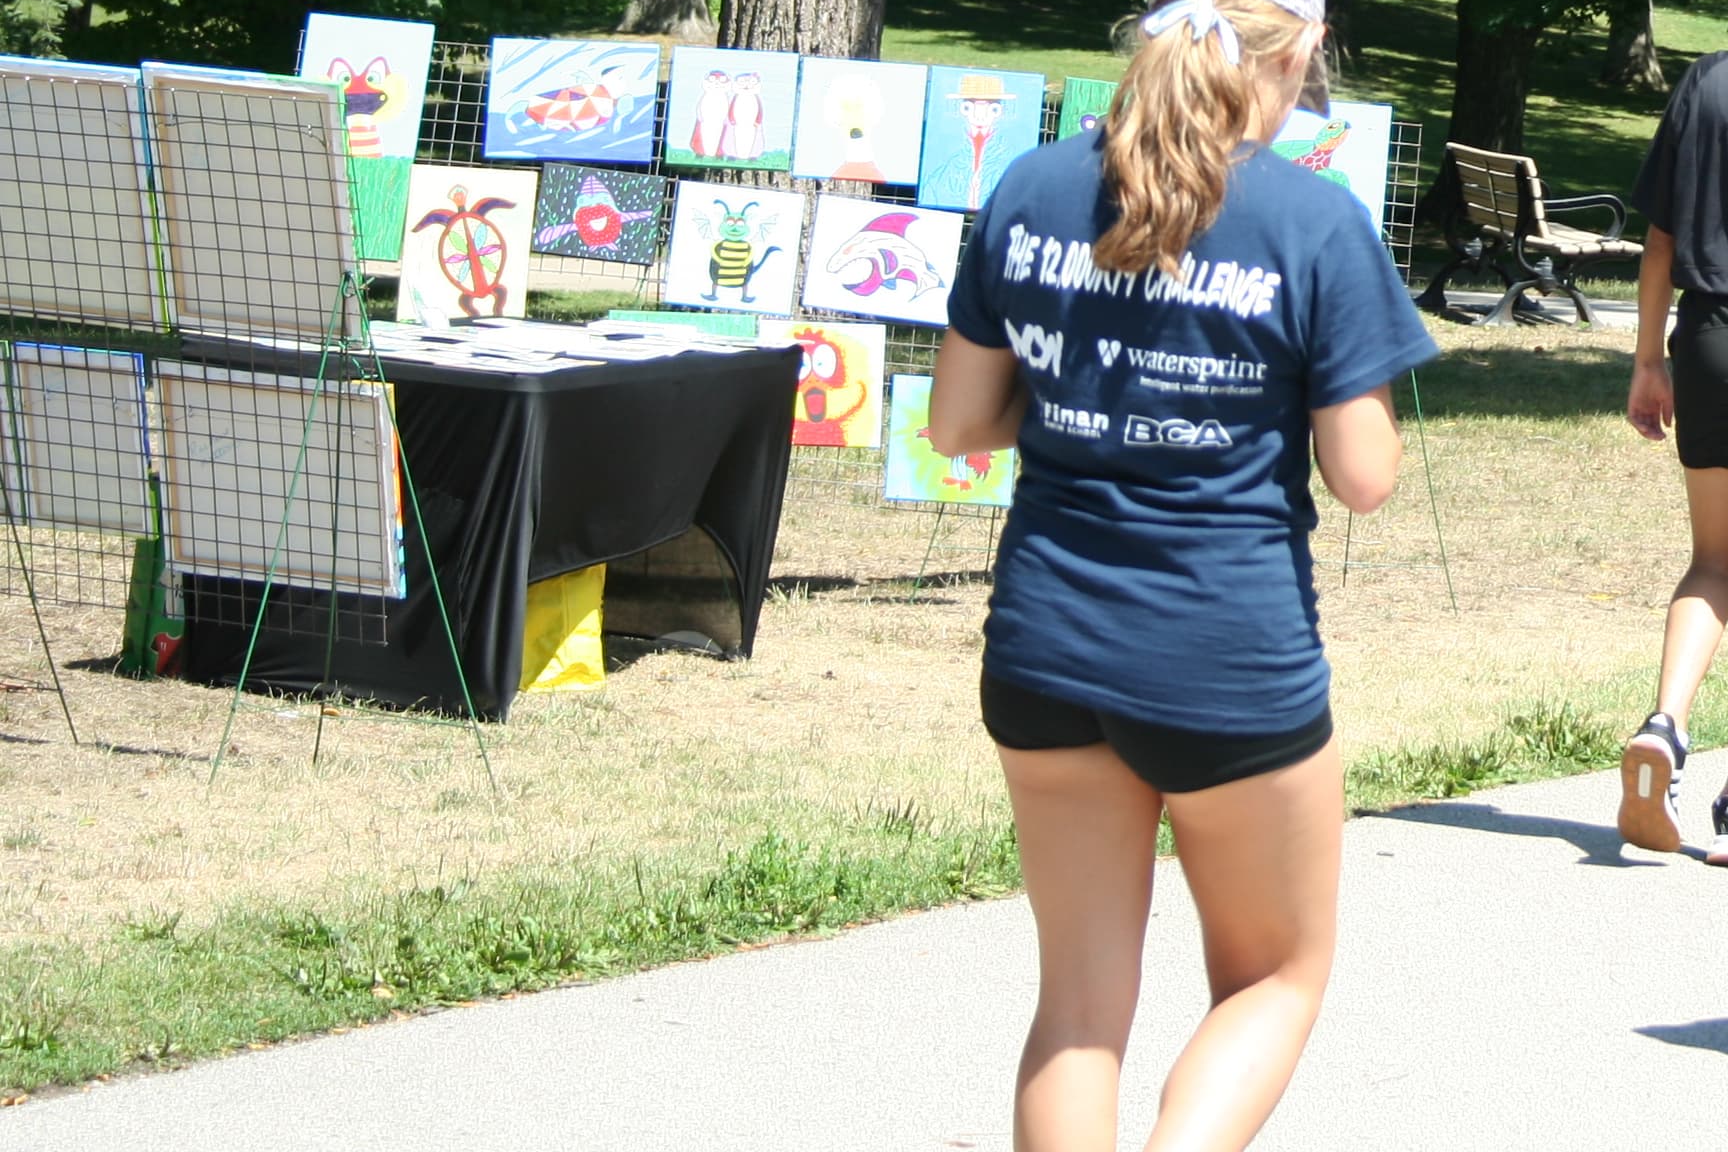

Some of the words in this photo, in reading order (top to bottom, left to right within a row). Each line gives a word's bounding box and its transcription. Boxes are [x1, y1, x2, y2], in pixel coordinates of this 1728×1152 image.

[1004, 224, 1041, 282] THE
[1127, 347, 1268, 383] watersprint
[1123, 414, 1233, 448] BCA
